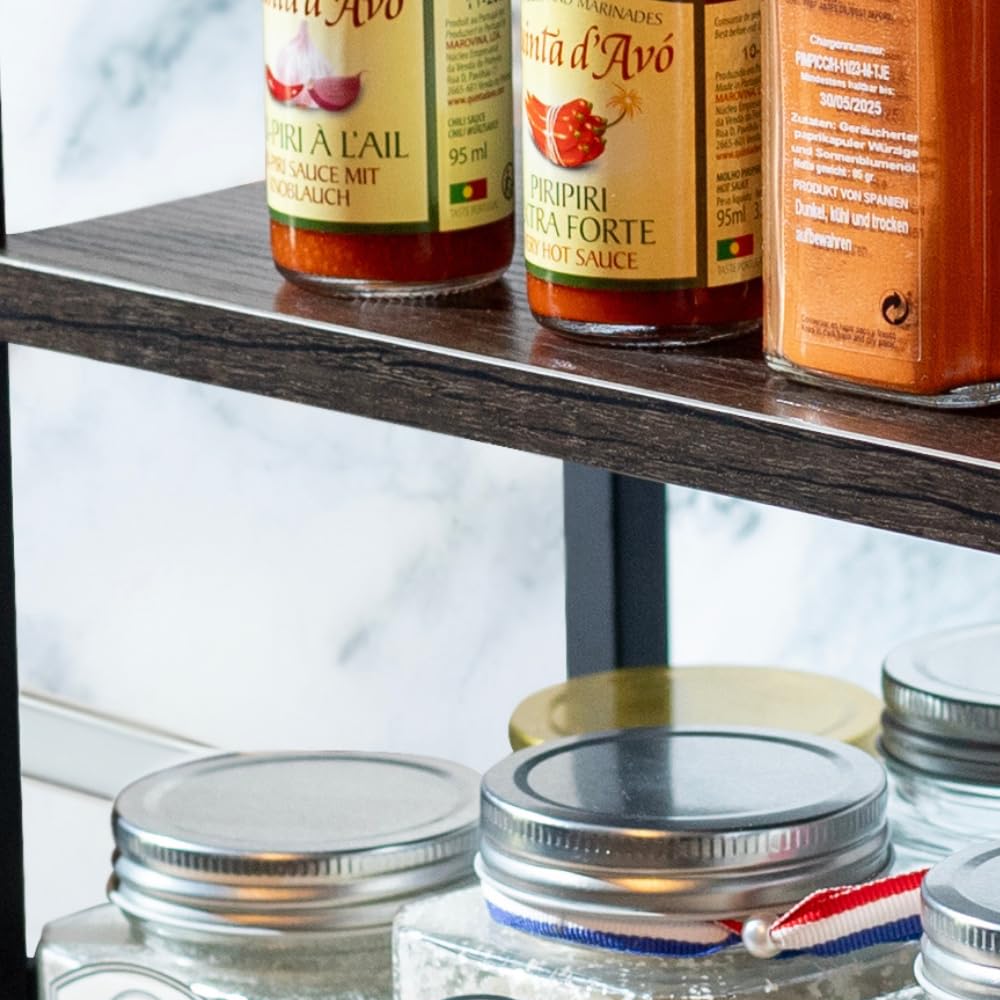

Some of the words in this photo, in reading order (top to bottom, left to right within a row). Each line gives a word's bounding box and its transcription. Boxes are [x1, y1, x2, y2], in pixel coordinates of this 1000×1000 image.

[578, 0, 664, 26] MARINADES
[570, 25, 674, 81] d'Avó
[819, 91, 882, 115] 30/05/2025
[791, 111, 837, 130] Zutaten:
[838, 121, 919, 143] Geräucherter
[310, 124, 331, 157] À
[341, 130, 409, 159] L'AIL
[449, 145, 468, 166] 95
[471, 141, 487, 162] ml
[791, 145, 813, 156] und
[289, 161, 339, 183] SAUCE
[345, 166, 379, 185] MIT
[269, 176, 350, 207] NOBLAUCH
[530, 174, 607, 213] PIRIPIRI
[793, 178, 838, 198] PRODUKT
[840, 187, 862, 202] VON
[863, 192, 909, 210] SPANIEN
[525, 203, 560, 237] TRA
[567, 215, 657, 245] FORTE
[716, 203, 747, 228] 95ml
[852, 211, 871, 228] und
[872, 211, 909, 234] trocken
[542, 242, 571, 265] HOT
[575, 248, 640, 270] SAUCE
